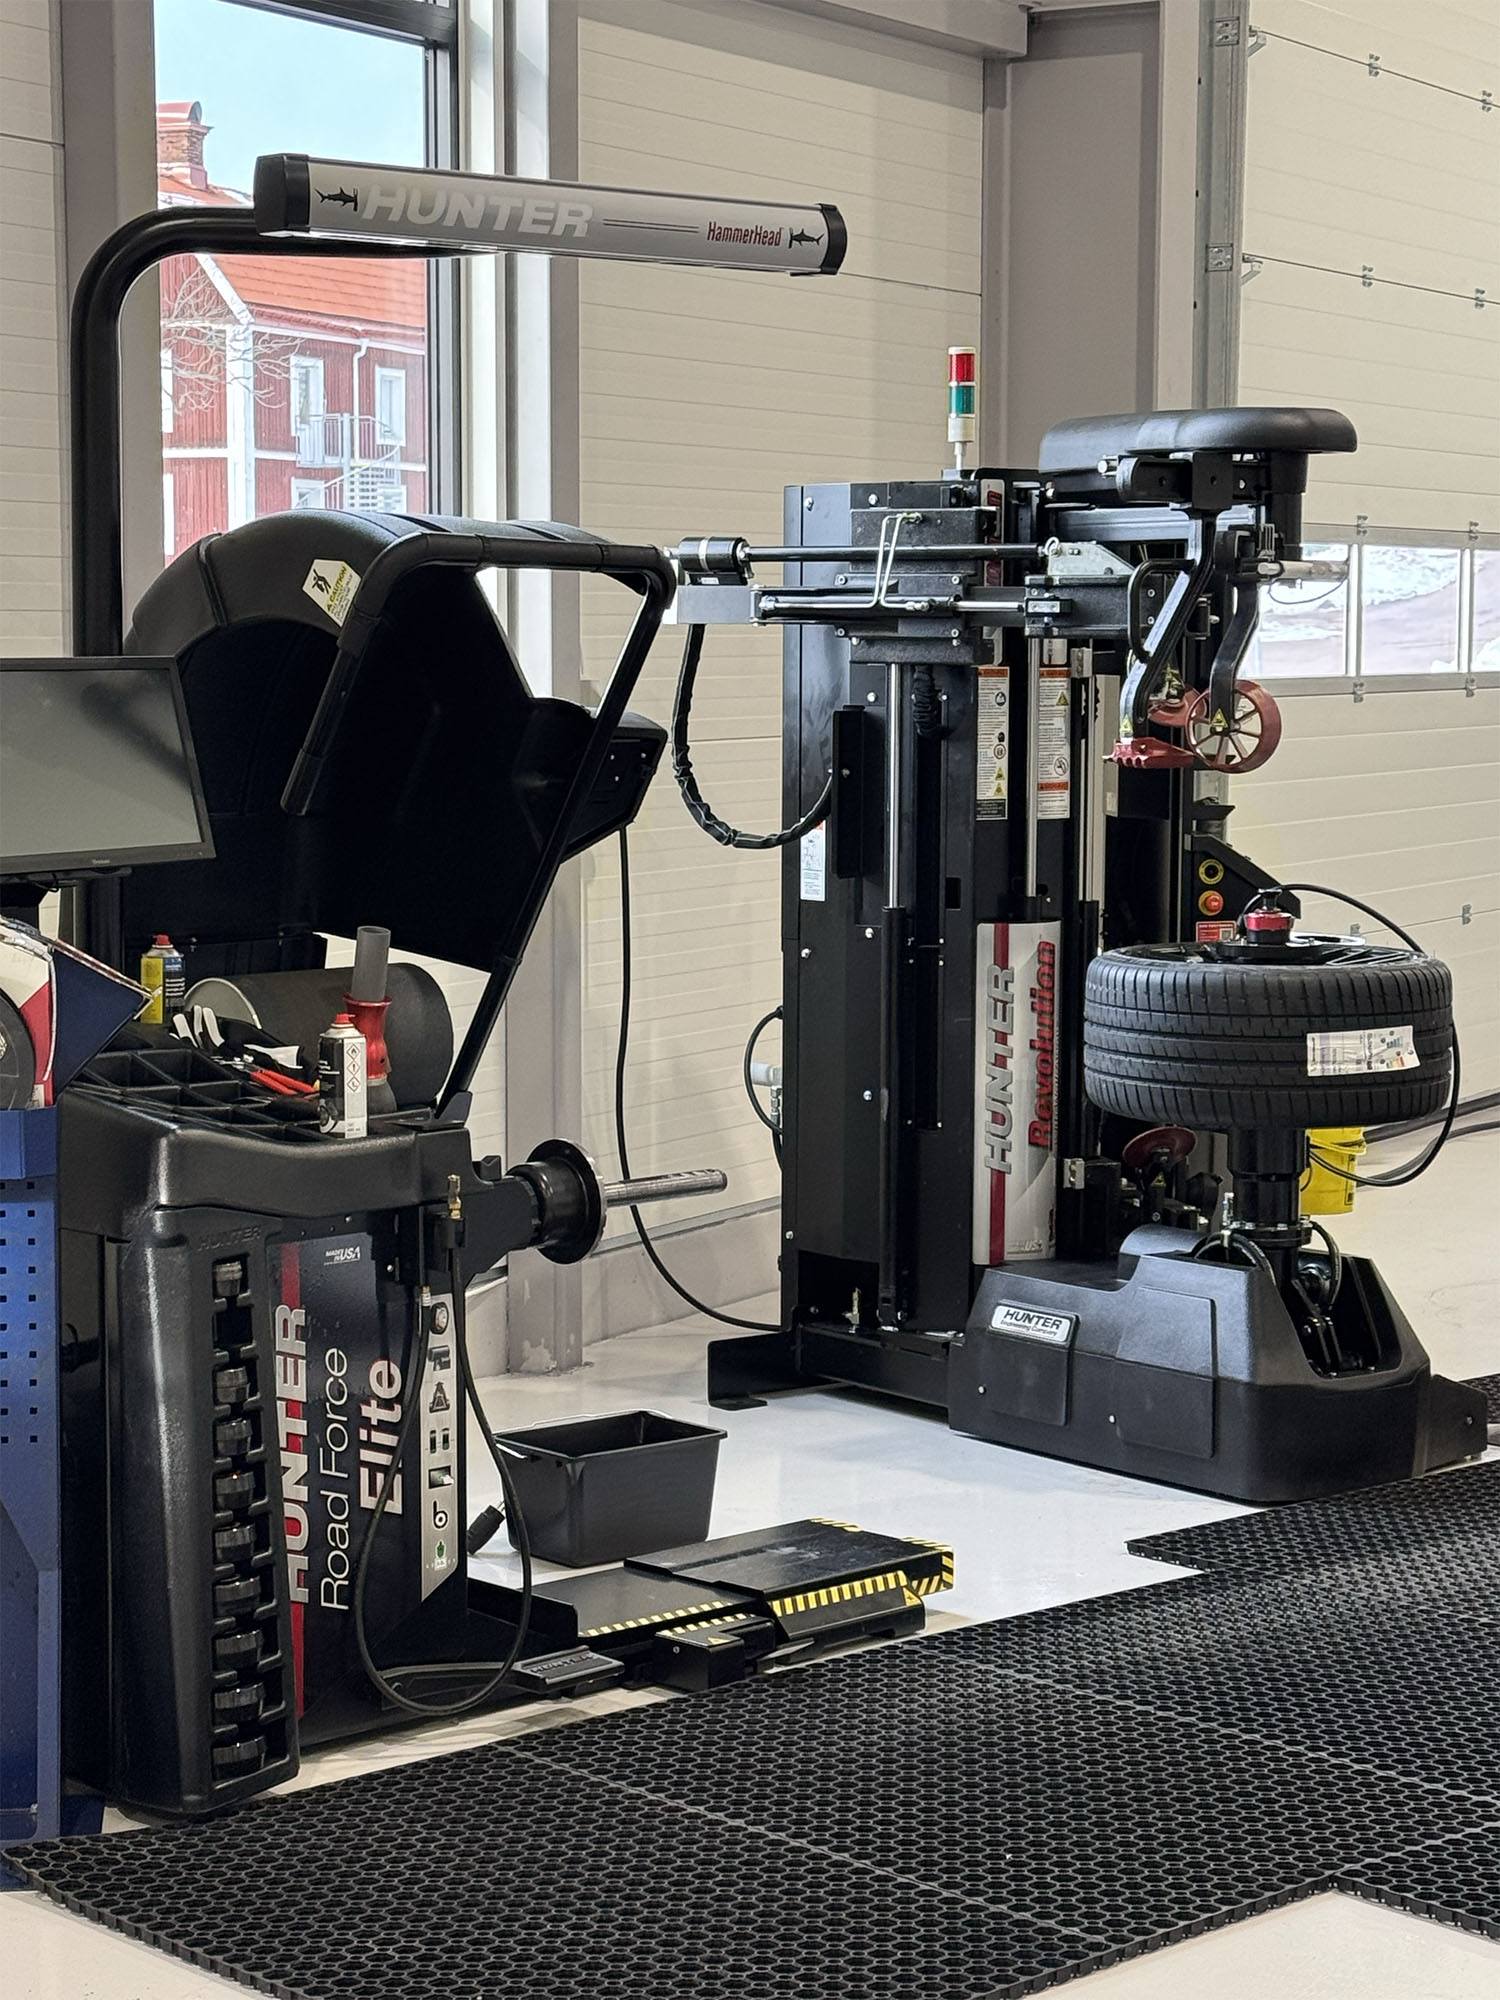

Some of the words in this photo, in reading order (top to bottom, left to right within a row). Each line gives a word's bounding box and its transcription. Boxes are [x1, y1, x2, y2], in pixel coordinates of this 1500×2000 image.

[360, 182, 593, 239] HUNTER
[707, 221, 782, 247] HammerHead
[985, 963, 1014, 1174] HUNTER
[1028, 940, 1055, 1150] Revolution
[341, 1246, 360, 1261] USA
[1003, 1309, 1063, 1331] HUNTER
[319, 1348, 348, 1478] Force
[358, 1358, 402, 1515] Elite
[320, 1490, 349, 1610] Road
